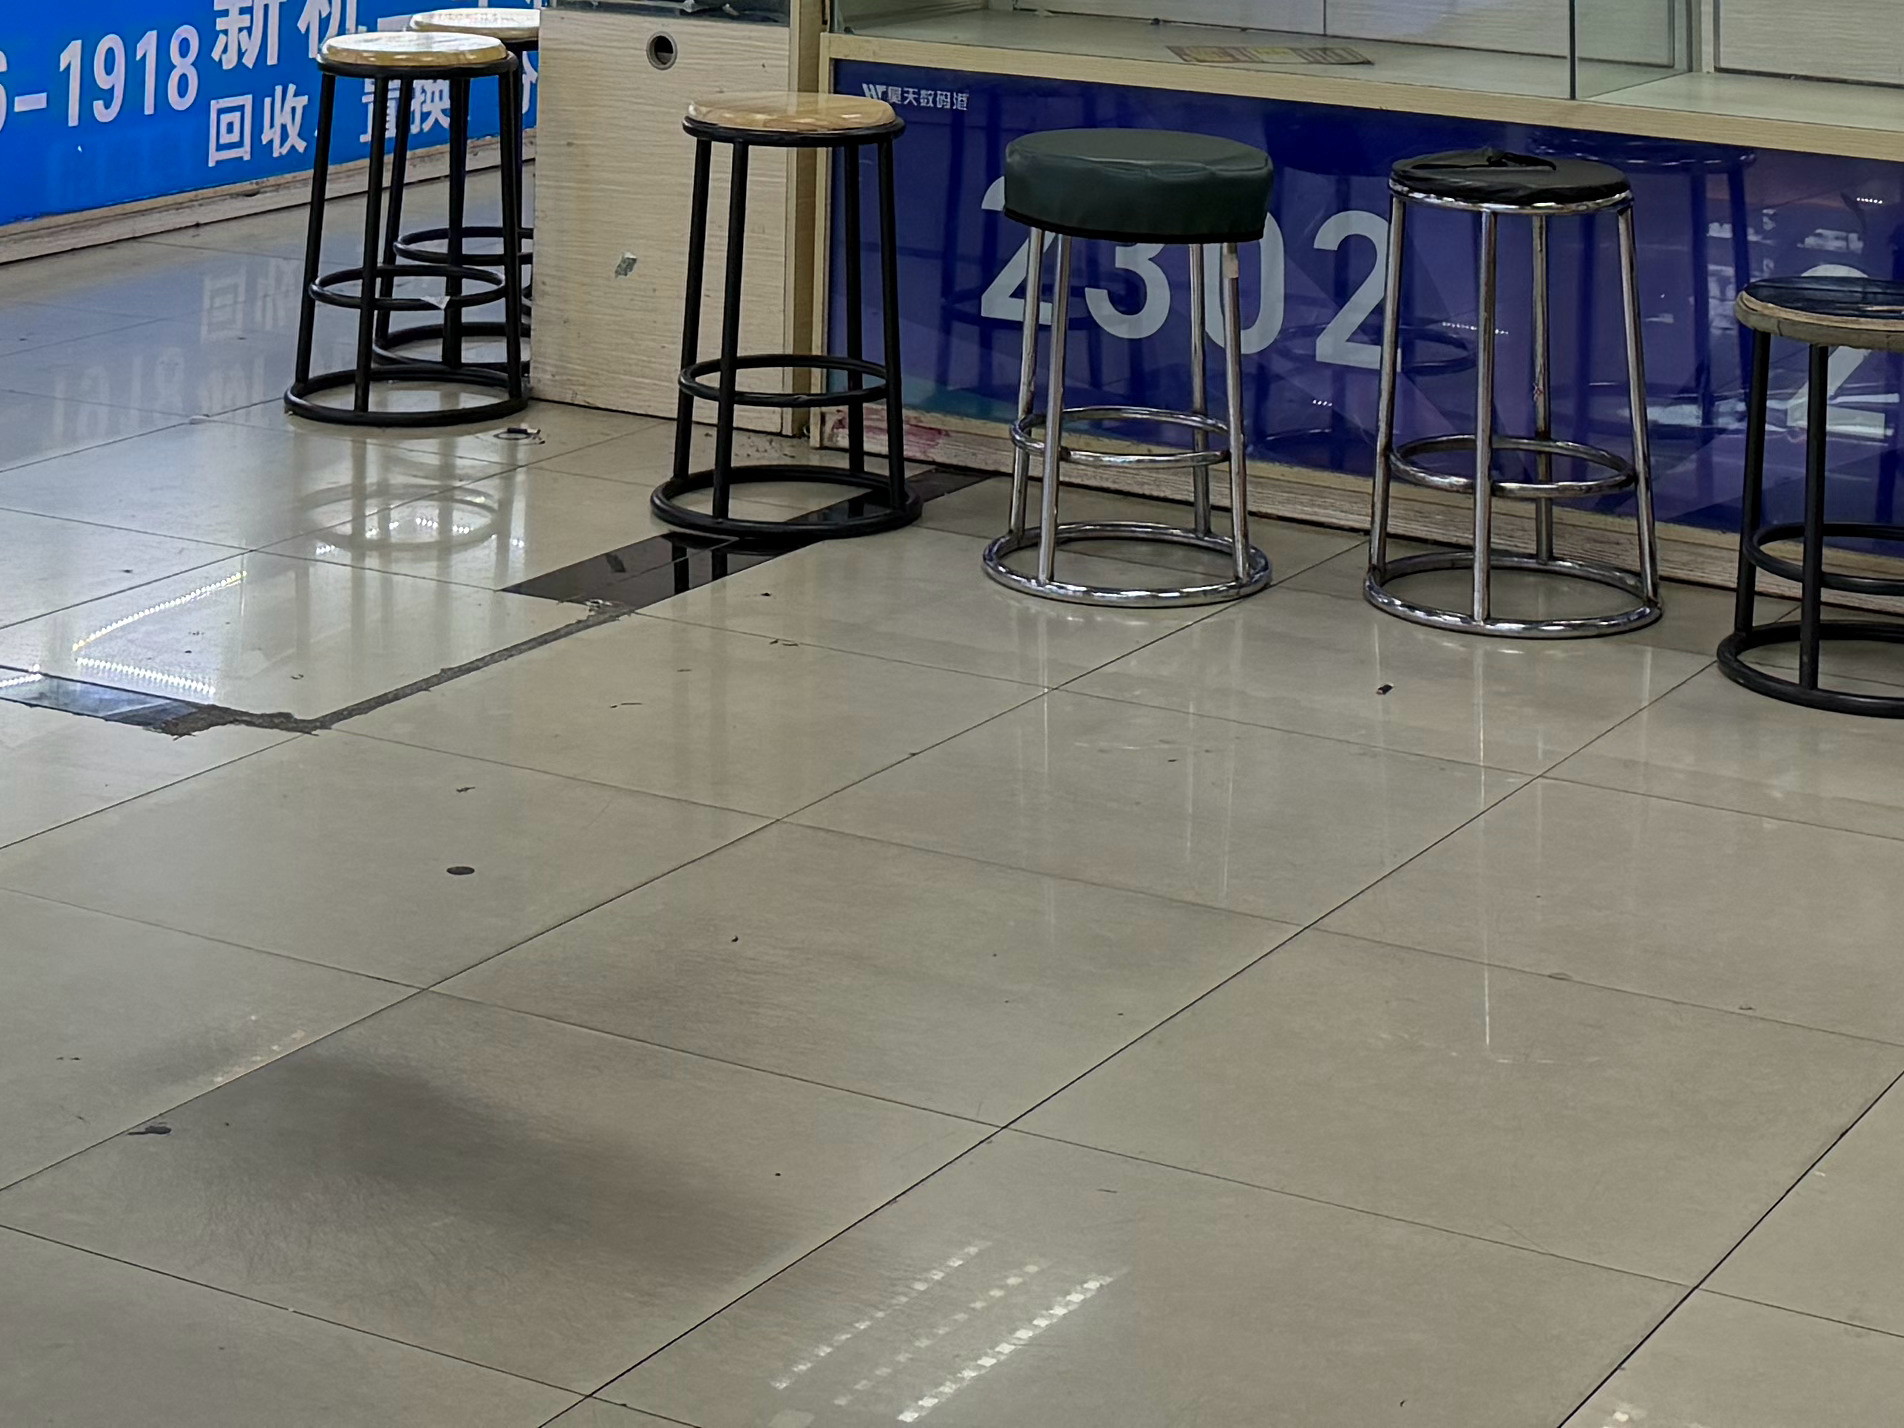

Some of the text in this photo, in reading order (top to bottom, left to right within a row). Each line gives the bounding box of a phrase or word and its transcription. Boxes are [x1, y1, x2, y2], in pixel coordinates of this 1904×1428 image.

[888, 86, 969, 111] 昊天数码港
